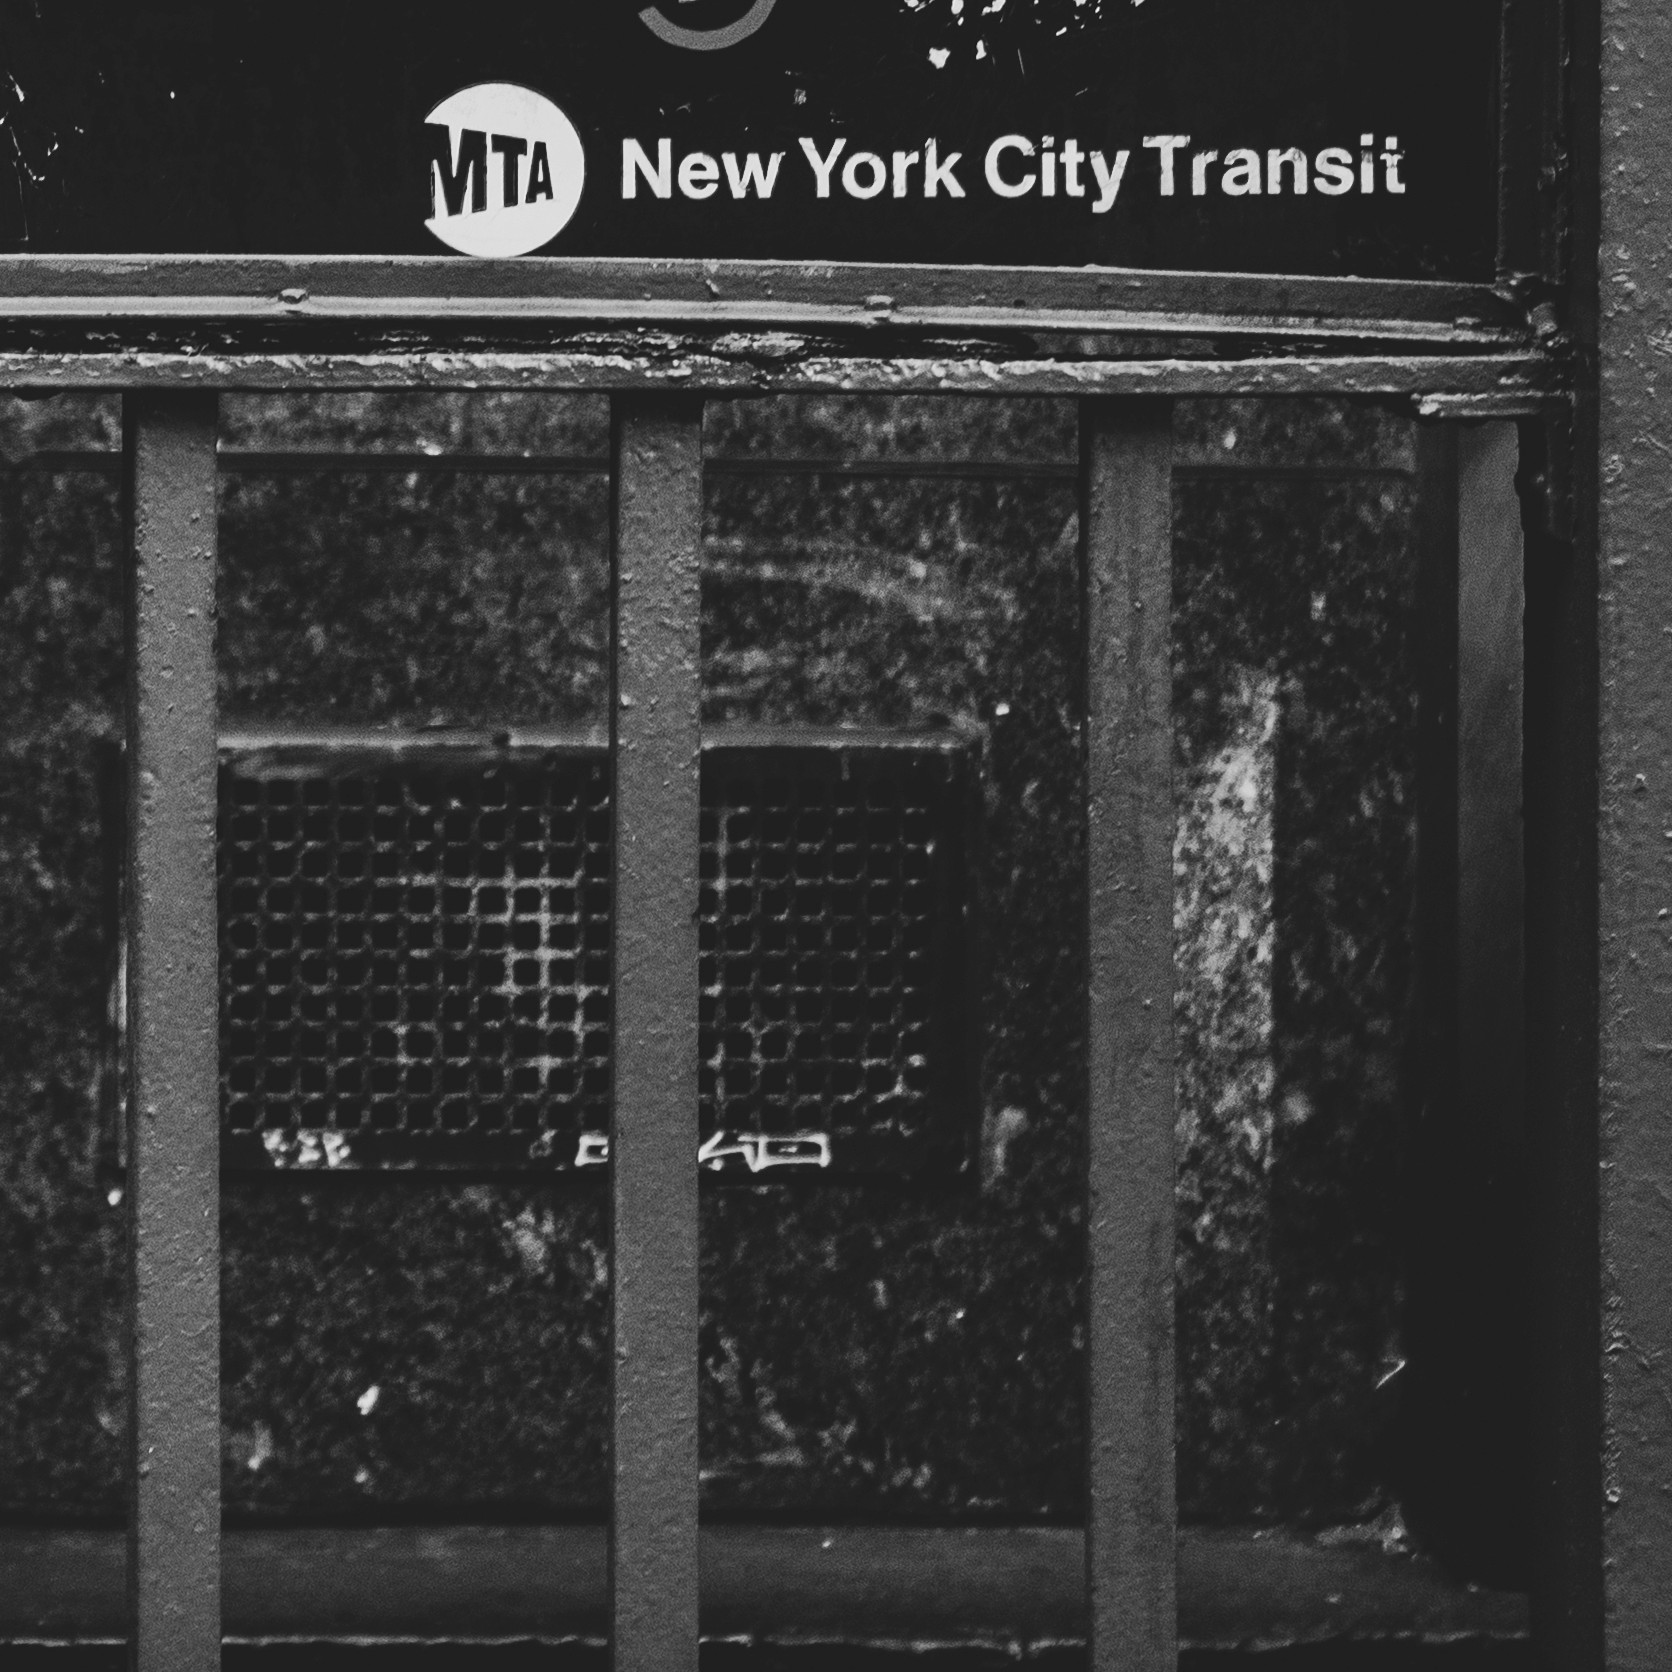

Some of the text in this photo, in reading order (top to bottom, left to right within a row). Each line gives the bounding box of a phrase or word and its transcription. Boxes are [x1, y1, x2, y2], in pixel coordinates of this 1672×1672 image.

[423, 121, 554, 220] MTA
[622, 132, 1406, 214] New York City Transit
